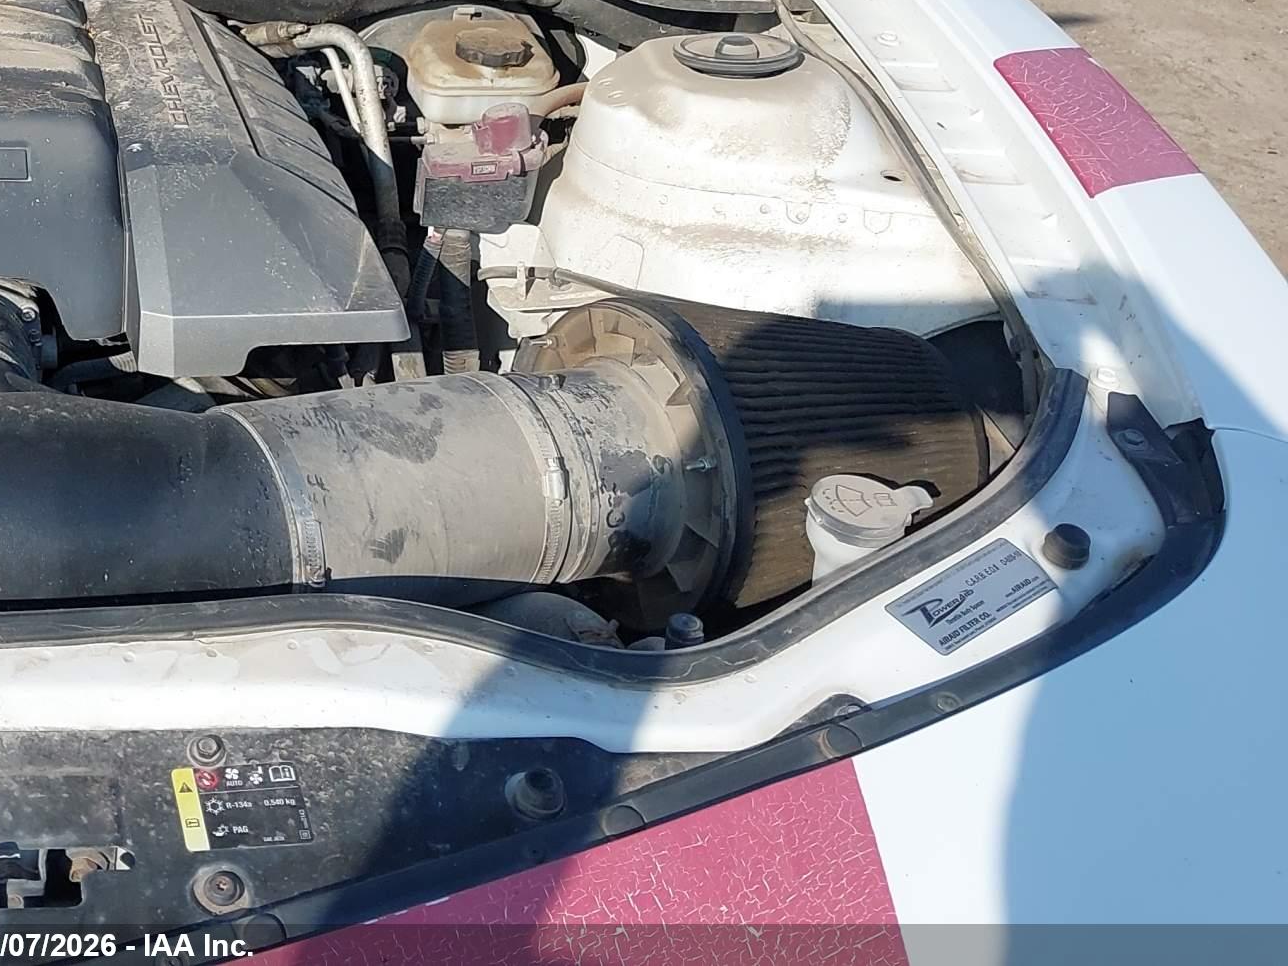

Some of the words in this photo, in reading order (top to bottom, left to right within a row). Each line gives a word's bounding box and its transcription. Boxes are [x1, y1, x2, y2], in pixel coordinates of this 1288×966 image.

[136, 13, 189, 129] CHEVROLET
[938, 631, 961, 647] AIRAID
[958, 617, 979, 634] FILTER
[285, 799, 296, 807] kg
